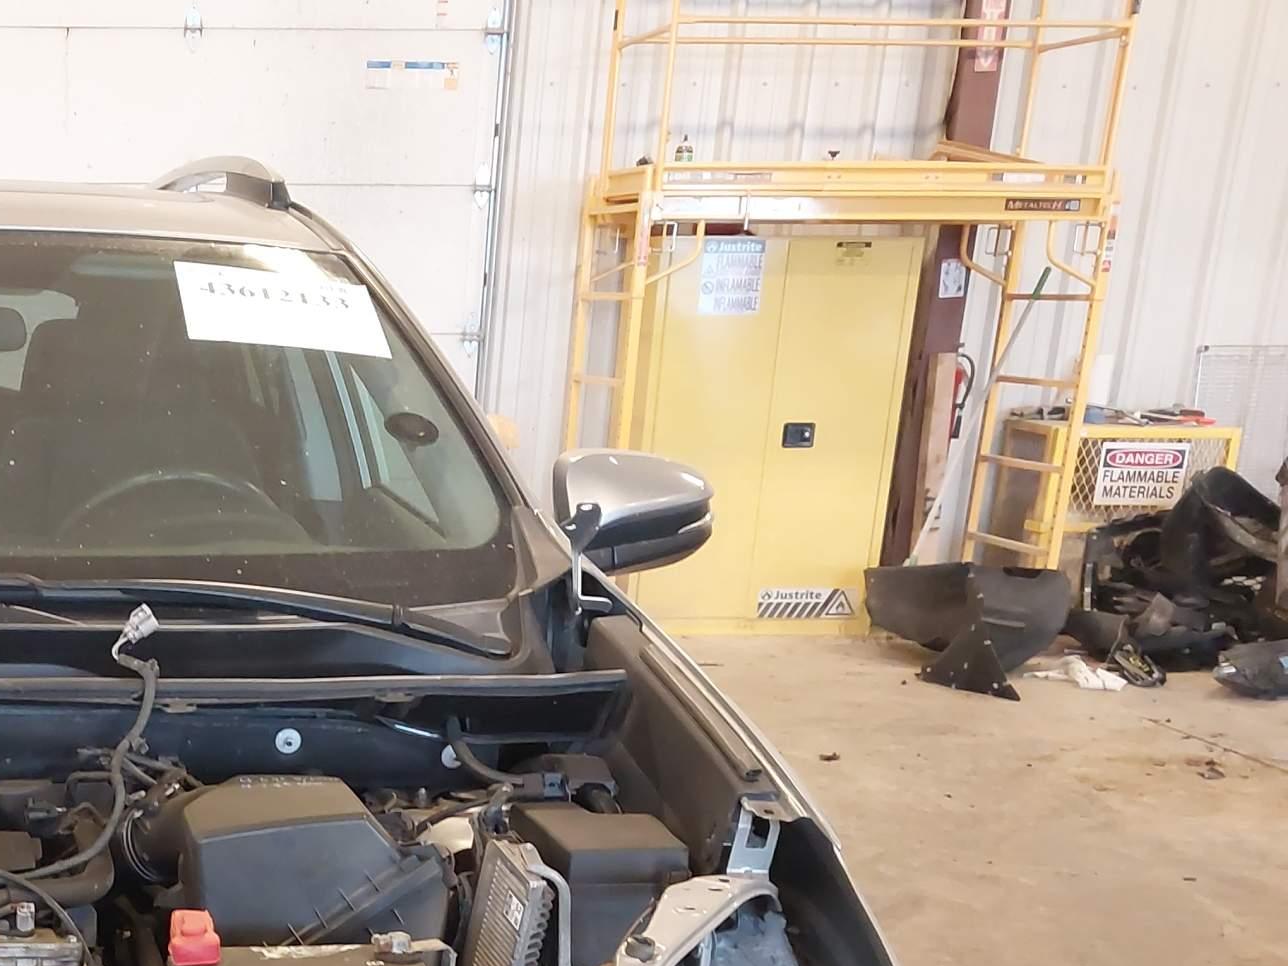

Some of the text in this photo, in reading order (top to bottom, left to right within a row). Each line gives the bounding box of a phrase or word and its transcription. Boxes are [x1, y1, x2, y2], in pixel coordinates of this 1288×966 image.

[719, 241, 763, 252] Justrite
[1115, 452, 1174, 465] DANGER
[1102, 470, 1181, 484] FLAMMABLE
[1101, 485, 1175, 500] MATERIALS
[774, 590, 822, 601] Justrite
